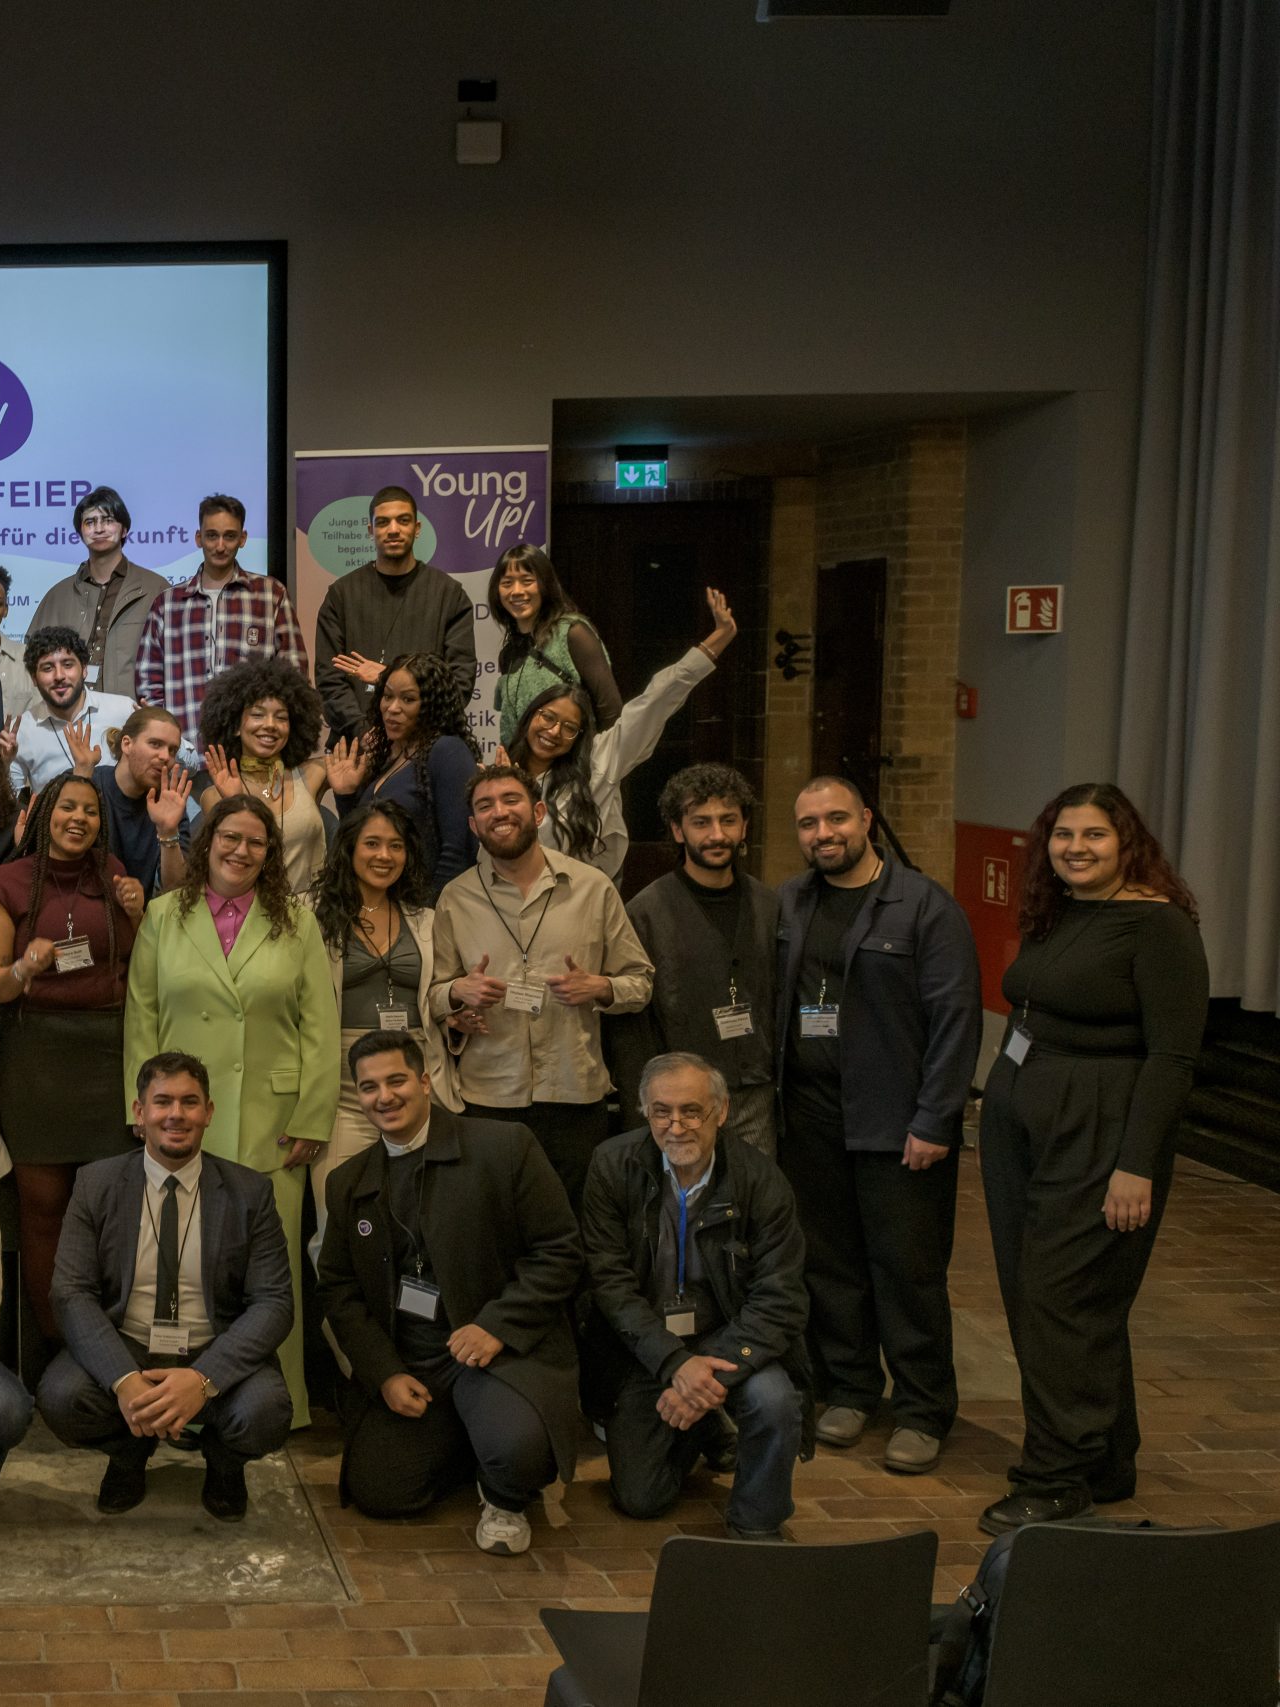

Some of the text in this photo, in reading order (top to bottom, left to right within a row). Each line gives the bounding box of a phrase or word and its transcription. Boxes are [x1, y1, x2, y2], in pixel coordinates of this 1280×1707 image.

[410, 463, 527, 504] Young
[328, 518, 359, 528] Junge
[464, 497, 536, 548] Up!
[0, 527, 36, 546] für
[45, 527, 81, 546] die
[126, 525, 189, 544] kunft
[322, 531, 362, 540] Teilhabe
